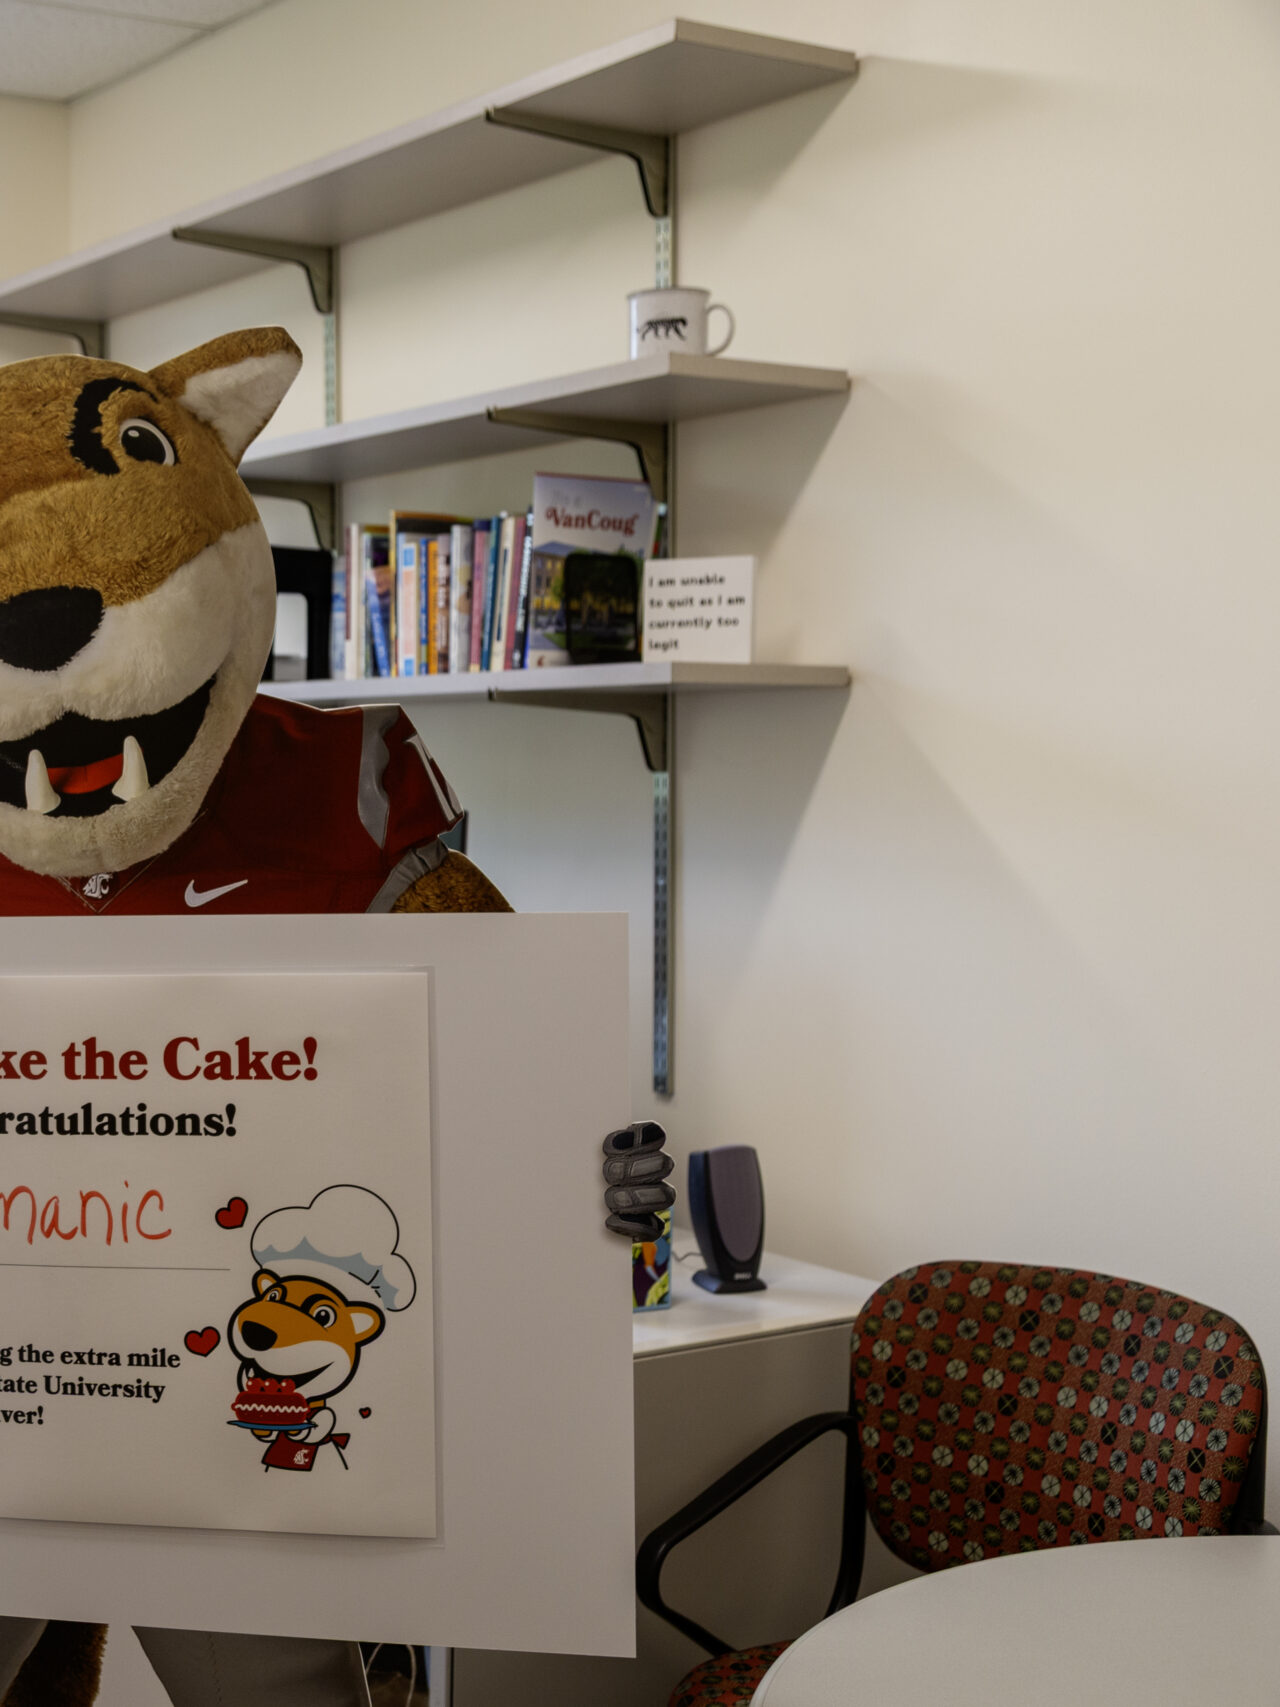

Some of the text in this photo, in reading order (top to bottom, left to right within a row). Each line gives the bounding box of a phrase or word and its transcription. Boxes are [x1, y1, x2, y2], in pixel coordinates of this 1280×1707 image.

[545, 507, 640, 536] VanCoug
[658, 577, 677, 588] am
[680, 573, 726, 587] unable
[649, 597, 665, 609] to
[667, 596, 694, 611] quit
[699, 597, 714, 607] as
[726, 596, 746, 606] am
[648, 615, 740, 630] currently too
[648, 638, 679, 653] legit
[60, 1035, 149, 1081] the
[162, 1035, 320, 1082] Cake!
[16, 1342, 55, 1366] the
[59, 1346, 123, 1368] extra
[126, 1347, 181, 1369] mile
[42, 1374, 167, 1404] University
